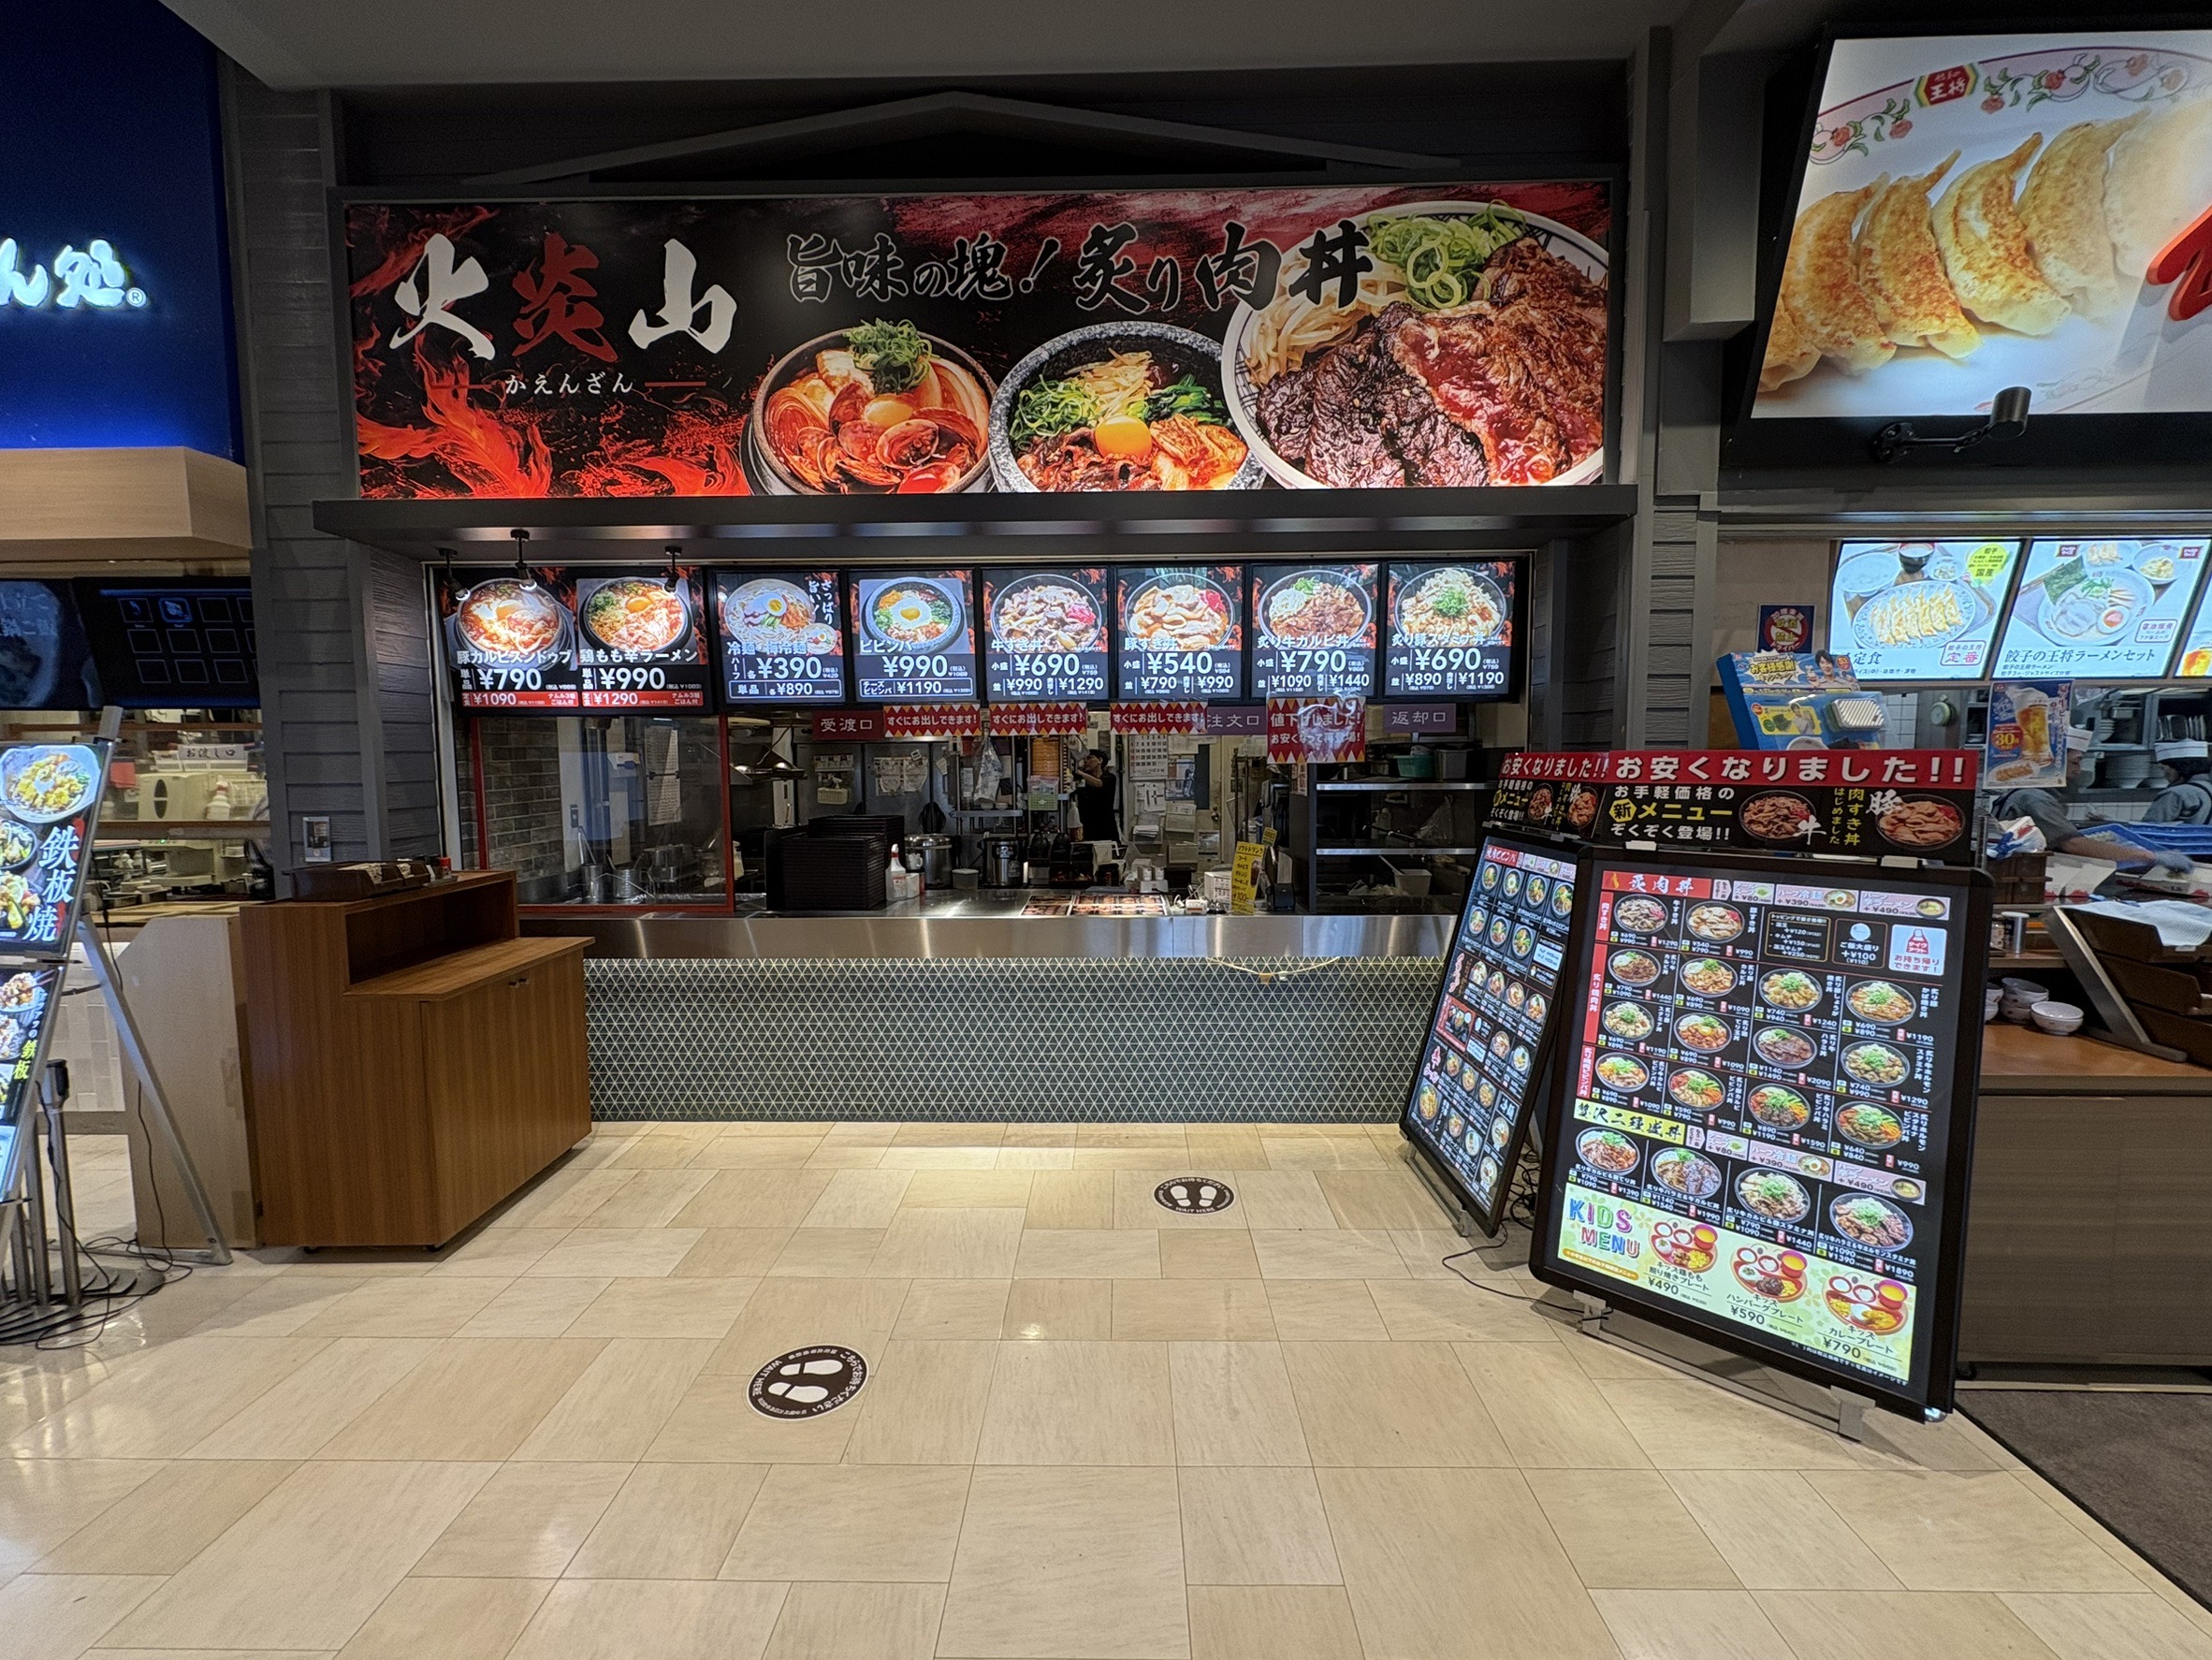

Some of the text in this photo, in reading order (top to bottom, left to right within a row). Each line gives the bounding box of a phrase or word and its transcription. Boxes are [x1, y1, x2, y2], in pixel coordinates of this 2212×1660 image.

[1074, 220, 1375, 313] 炙り肉丼
[389, 232, 738, 361] 火炎山
[505, 373, 633, 395] かえんざん
[821, 580, 834, 625] さっぱり
[861, 639, 913, 654] ビビンバ
[991, 638, 1044, 652] 牛すき丼
[1124, 637, 1179, 651] 豚すき丼
[1257, 633, 1349, 648] 炙り牛カルビ丼
[1391, 632, 1486, 647] 炙り豚スタミナ丼
[1947, 643, 1982, 651] 餃子の王将
[456, 648, 573, 665] 豚カルビスンドゥブ
[579, 648, 699, 663] 鶏もも辛ラーメン
[1123, 651, 1214, 675] 小盛 ¥540
[1257, 649, 1347, 673] 小盛 ¥790
[1390, 648, 1482, 671] 小盛 ¥690
[1945, 652, 1978, 663] 定番
[2005, 648, 2155, 663] 餃子の王将ラーメンセット
[731, 657, 741, 680] ハーフ
[756, 656, 822, 679] ¥390
[881, 655, 949, 677] ¥990
[991, 653, 1081, 677] 小盛 ¥690
[460, 667, 543, 691] 単品 ¥790
[581, 667, 666, 691] 単品 ¥990
[1006, 677, 1043, 692] ¥990
[1058, 677, 1104, 691] ¥1290
[1141, 676, 1178, 690] ¥790
[1198, 676, 1234, 689] ¥990
[1272, 675, 1312, 689] ¥1090
[1329, 673, 1370, 687] ¥1440
[1404, 672, 1443, 686] ¥890
[1458, 671, 1506, 685] ¥1190
[737, 682, 813, 695] 単品 ¥890
[896, 681, 942, 694] ¥1190
[473, 692, 517, 706] ¥1090
[593, 692, 639, 706] ¥1290
[821, 718, 873, 732] 受渡口
[887, 714, 978, 726] すぐにお出しできます!
[993, 712, 1084, 724] すぐにお出しできます!
[1113, 712, 1204, 724] すぐにお出しできます!
[1271, 710, 1361, 727] 値下げしました!
[1392, 711, 1447, 724] 返却口
[1502, 756, 1608, 779] お安くなりました!!
[1615, 755, 1963, 784] お安くなりました!!
[1614, 785, 1735, 800] お手軽価格の
[1866, 789, 1903, 815] 豚
[1612, 802, 1733, 821] 新 メニュー
[1829, 787, 1845, 844] はじめました
[1844, 788, 1865, 846] 肉すき丼
[1610, 823, 1730, 840] ぞくぞく登場!!
[1793, 814, 1827, 846] 牛
[22, 825, 79, 941] 鉄板焼
[1629, 874, 1695, 896] 炙肉丼
[1785, 898, 1809, 907] ¥390
[1872, 906, 1899, 915] ¥490
[1839, 941, 1880, 952] ご飯大盛り
[1841, 950, 1876, 961] +¥100
[1894, 954, 1940, 966] お持ち帰り
[1894, 963, 1937, 973] できます!
[1906, 1033, 1934, 1042] ¥1190
[1900, 1095, 1928, 1105] ¥1290
[1759, 1157, 1783, 1168] ¥390
[1847, 1179, 1874, 1191] ¥490
[1569, 1198, 1633, 1233] KIDS
[1581, 1227, 1640, 1259] MENU
[1785, 1235, 1812, 1248] ¥1440
[1649, 1265, 1710, 1292] 照り焼きプレート
[1657, 1260, 1704, 1283] キッズ鶏もも
[1885, 1264, 1914, 1277] ¥1890
[1648, 1276, 1680, 1295] ¥490
[1726, 1292, 1804, 1324] ハンバーグプレート
[1753, 1293, 1779, 1308] キッズ
[1730, 1304, 1766, 1326] ¥590
[1847, 1324, 1876, 1341] キッズ
[1824, 1336, 1861, 1360] ¥790
[1828, 1327, 1894, 1355] カレープレート
[751, 1360, 783, 1397] WAIT HERE
